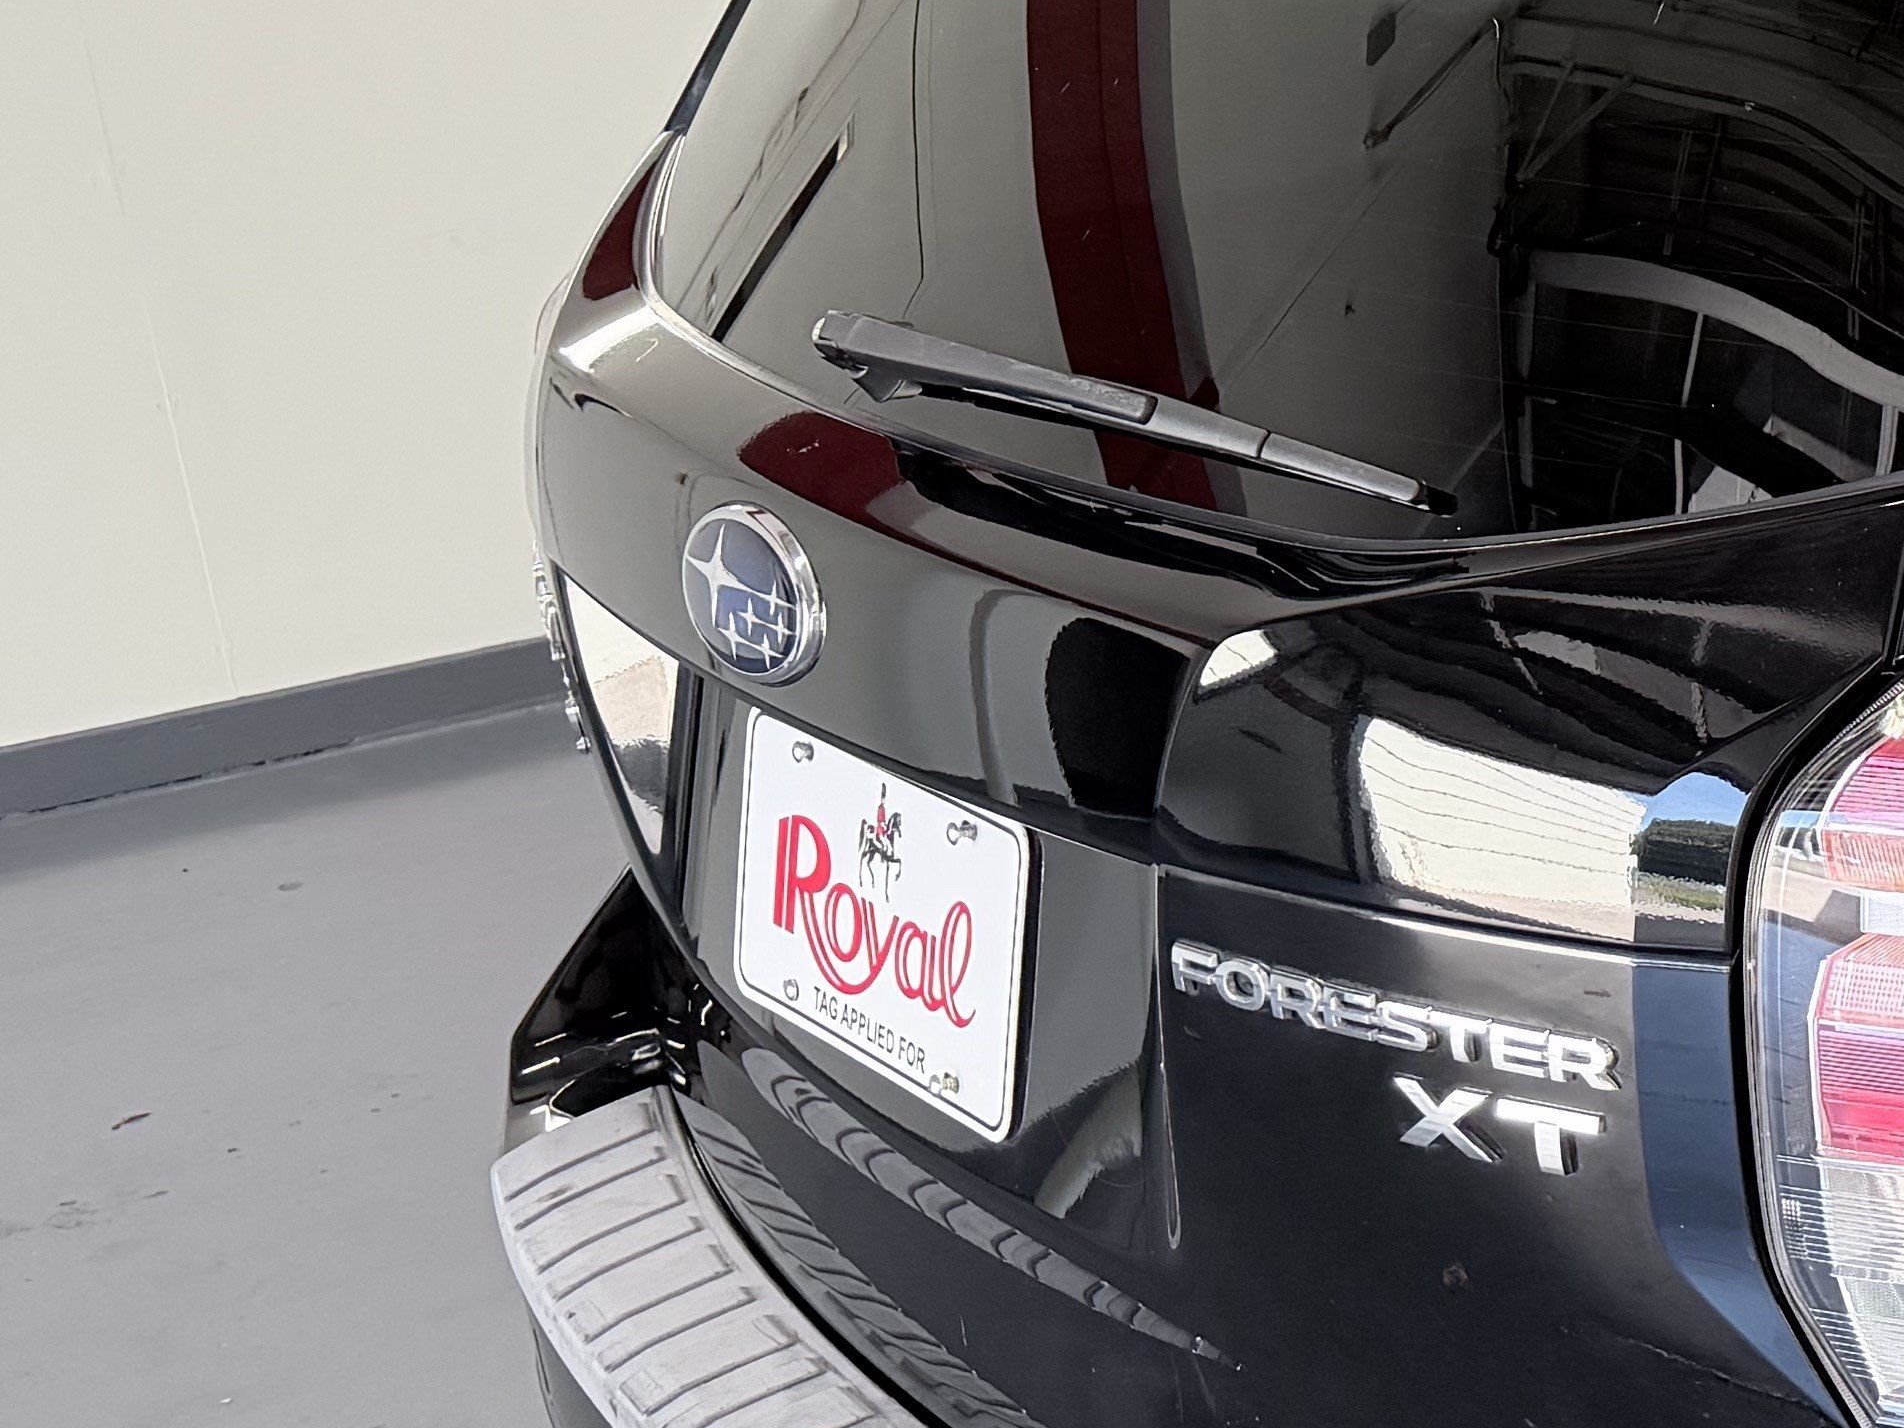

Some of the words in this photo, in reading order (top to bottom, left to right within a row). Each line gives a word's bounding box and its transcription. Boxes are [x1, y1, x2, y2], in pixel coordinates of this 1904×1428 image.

[772, 814, 976, 1028] Royal
[813, 985, 838, 1021] TAG
[840, 1003, 895, 1055] APPLIED
[897, 1035, 926, 1075] FOR
[1171, 940, 1621, 1092] FORESTER
[1393, 1074, 1606, 1176] XT
